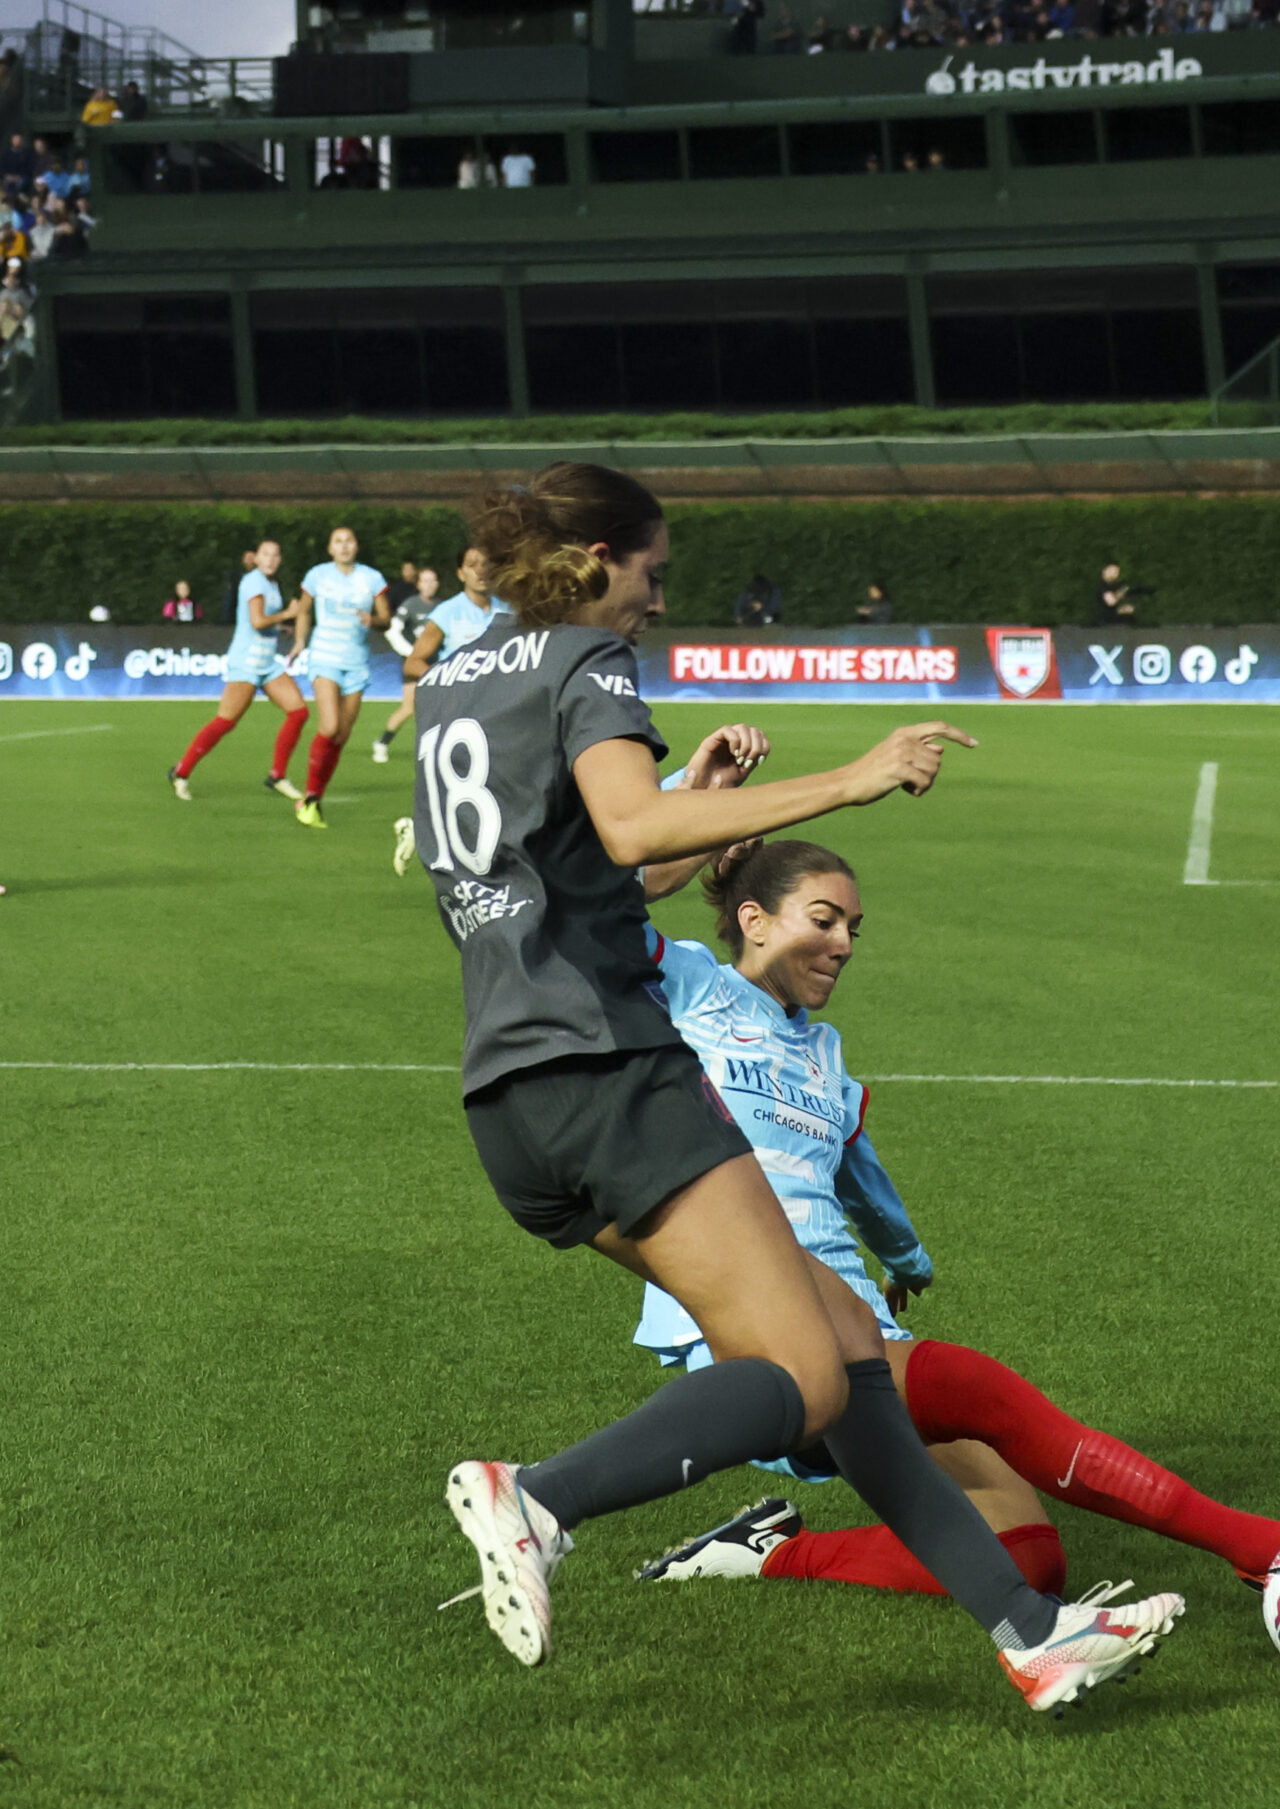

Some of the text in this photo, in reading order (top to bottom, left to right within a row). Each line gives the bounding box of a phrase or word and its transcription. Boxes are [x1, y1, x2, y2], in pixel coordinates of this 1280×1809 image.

[959, 47, 1202, 93] tastytrade
[673, 648, 956, 681] FOLLOW THE STARS
[418, 717, 502, 876] 18
[753, 1108, 810, 1137] CHICAGO'S
